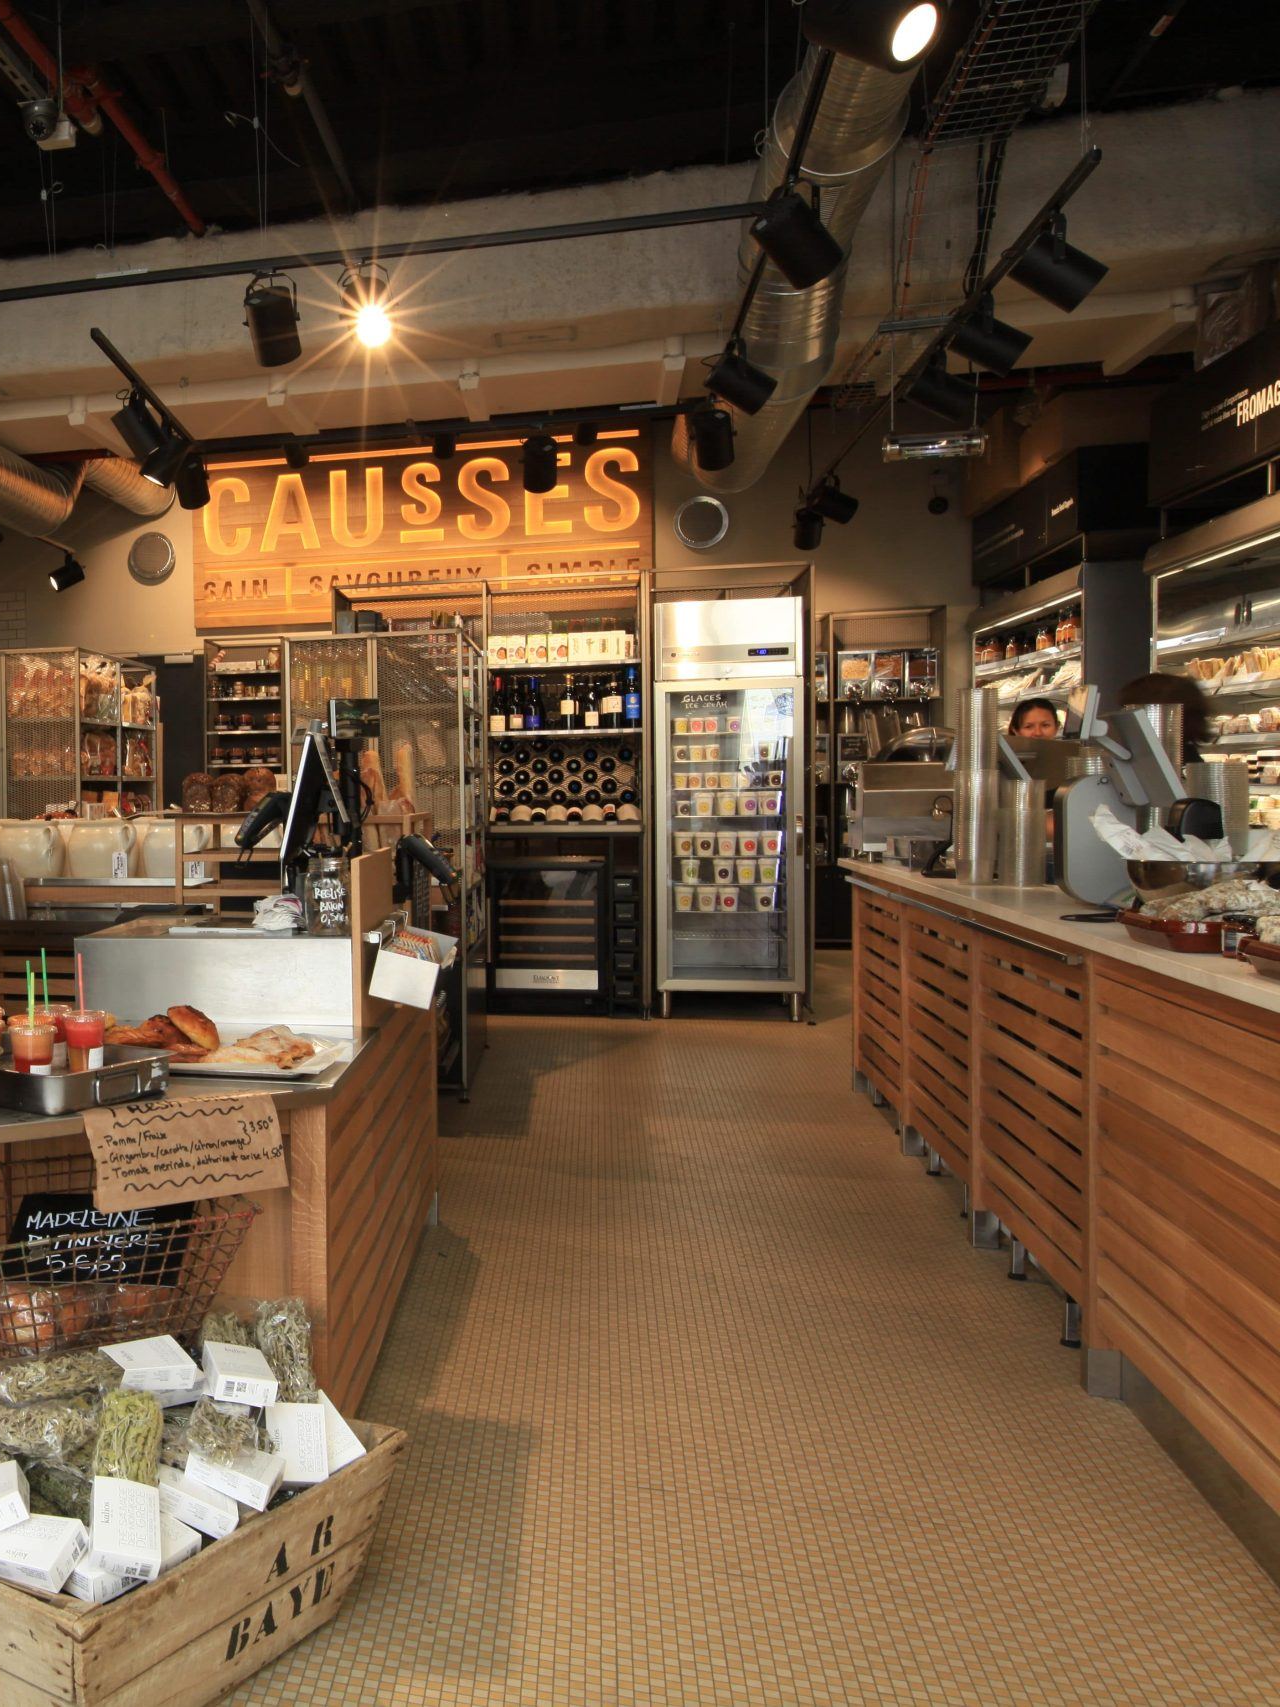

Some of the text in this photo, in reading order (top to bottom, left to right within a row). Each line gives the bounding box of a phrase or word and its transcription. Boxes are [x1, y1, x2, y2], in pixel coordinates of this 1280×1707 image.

[203, 447, 640, 556] CAUSSES
[203, 579, 269, 601] SAIN
[681, 694, 722, 703] GLACES
[26, 1209, 157, 1230] MADELEINE
[264, 1541, 290, 1584] A
